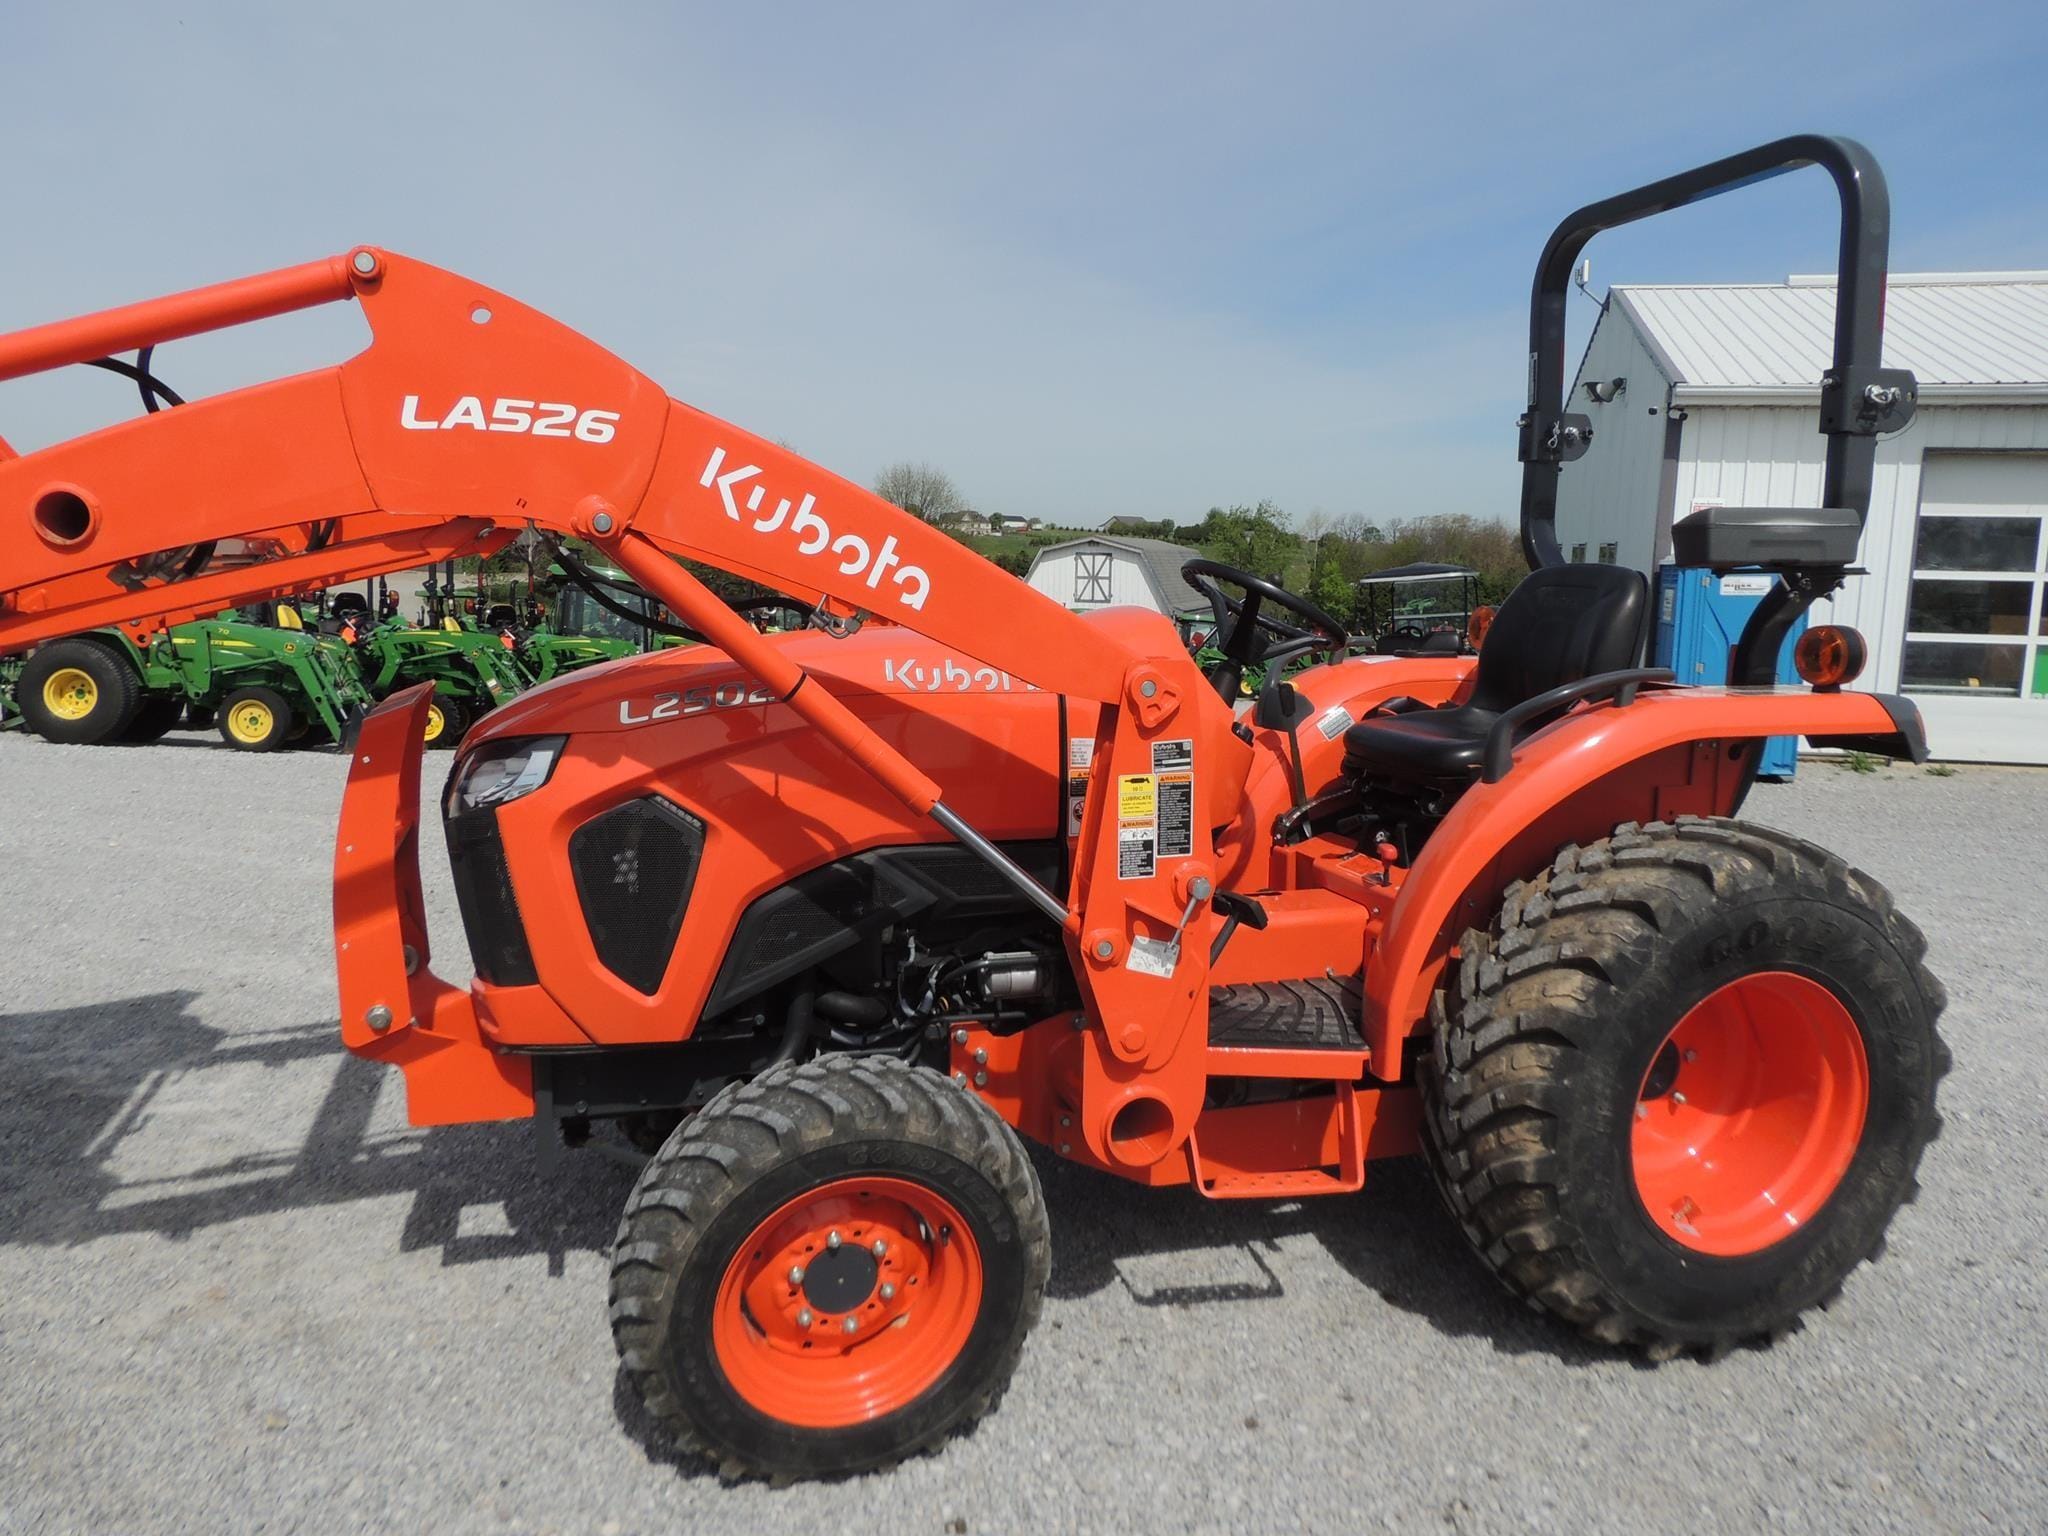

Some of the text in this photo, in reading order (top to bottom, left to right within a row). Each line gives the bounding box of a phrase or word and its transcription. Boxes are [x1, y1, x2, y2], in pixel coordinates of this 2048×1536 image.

[400, 395, 621, 444] LA526
[699, 446, 930, 611] Kubota
[884, 658, 1042, 691] Kubo
